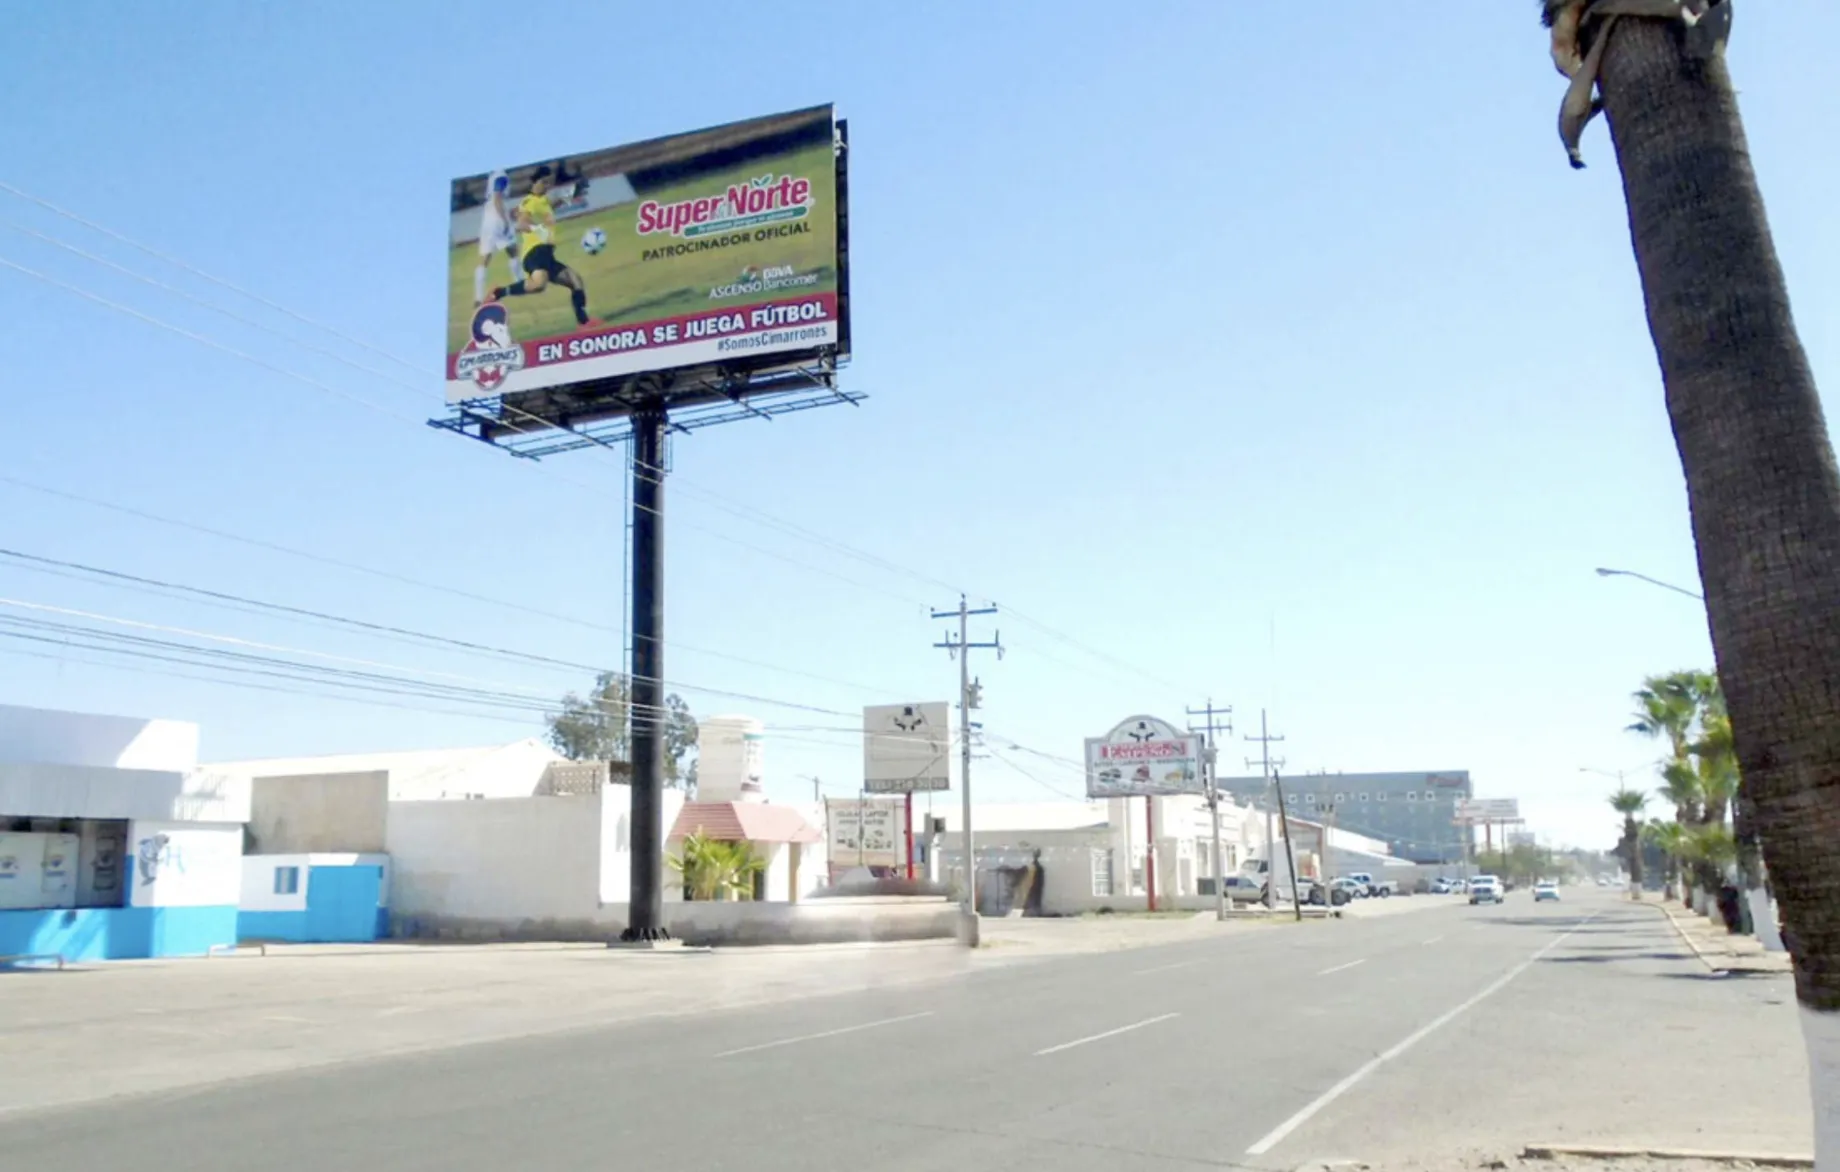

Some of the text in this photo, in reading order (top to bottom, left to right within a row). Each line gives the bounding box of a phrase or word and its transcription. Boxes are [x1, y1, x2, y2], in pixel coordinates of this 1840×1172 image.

[642, 234, 751, 261] PATROCINADOR
[754, 222, 811, 241] OFICIAL
[709, 274, 818, 299] ASCENSO Bancomer
[538, 301, 828, 362] EN SONORA SE JUEGA FÚTBOL
[717, 326, 828, 350] #SomosCimarrones
